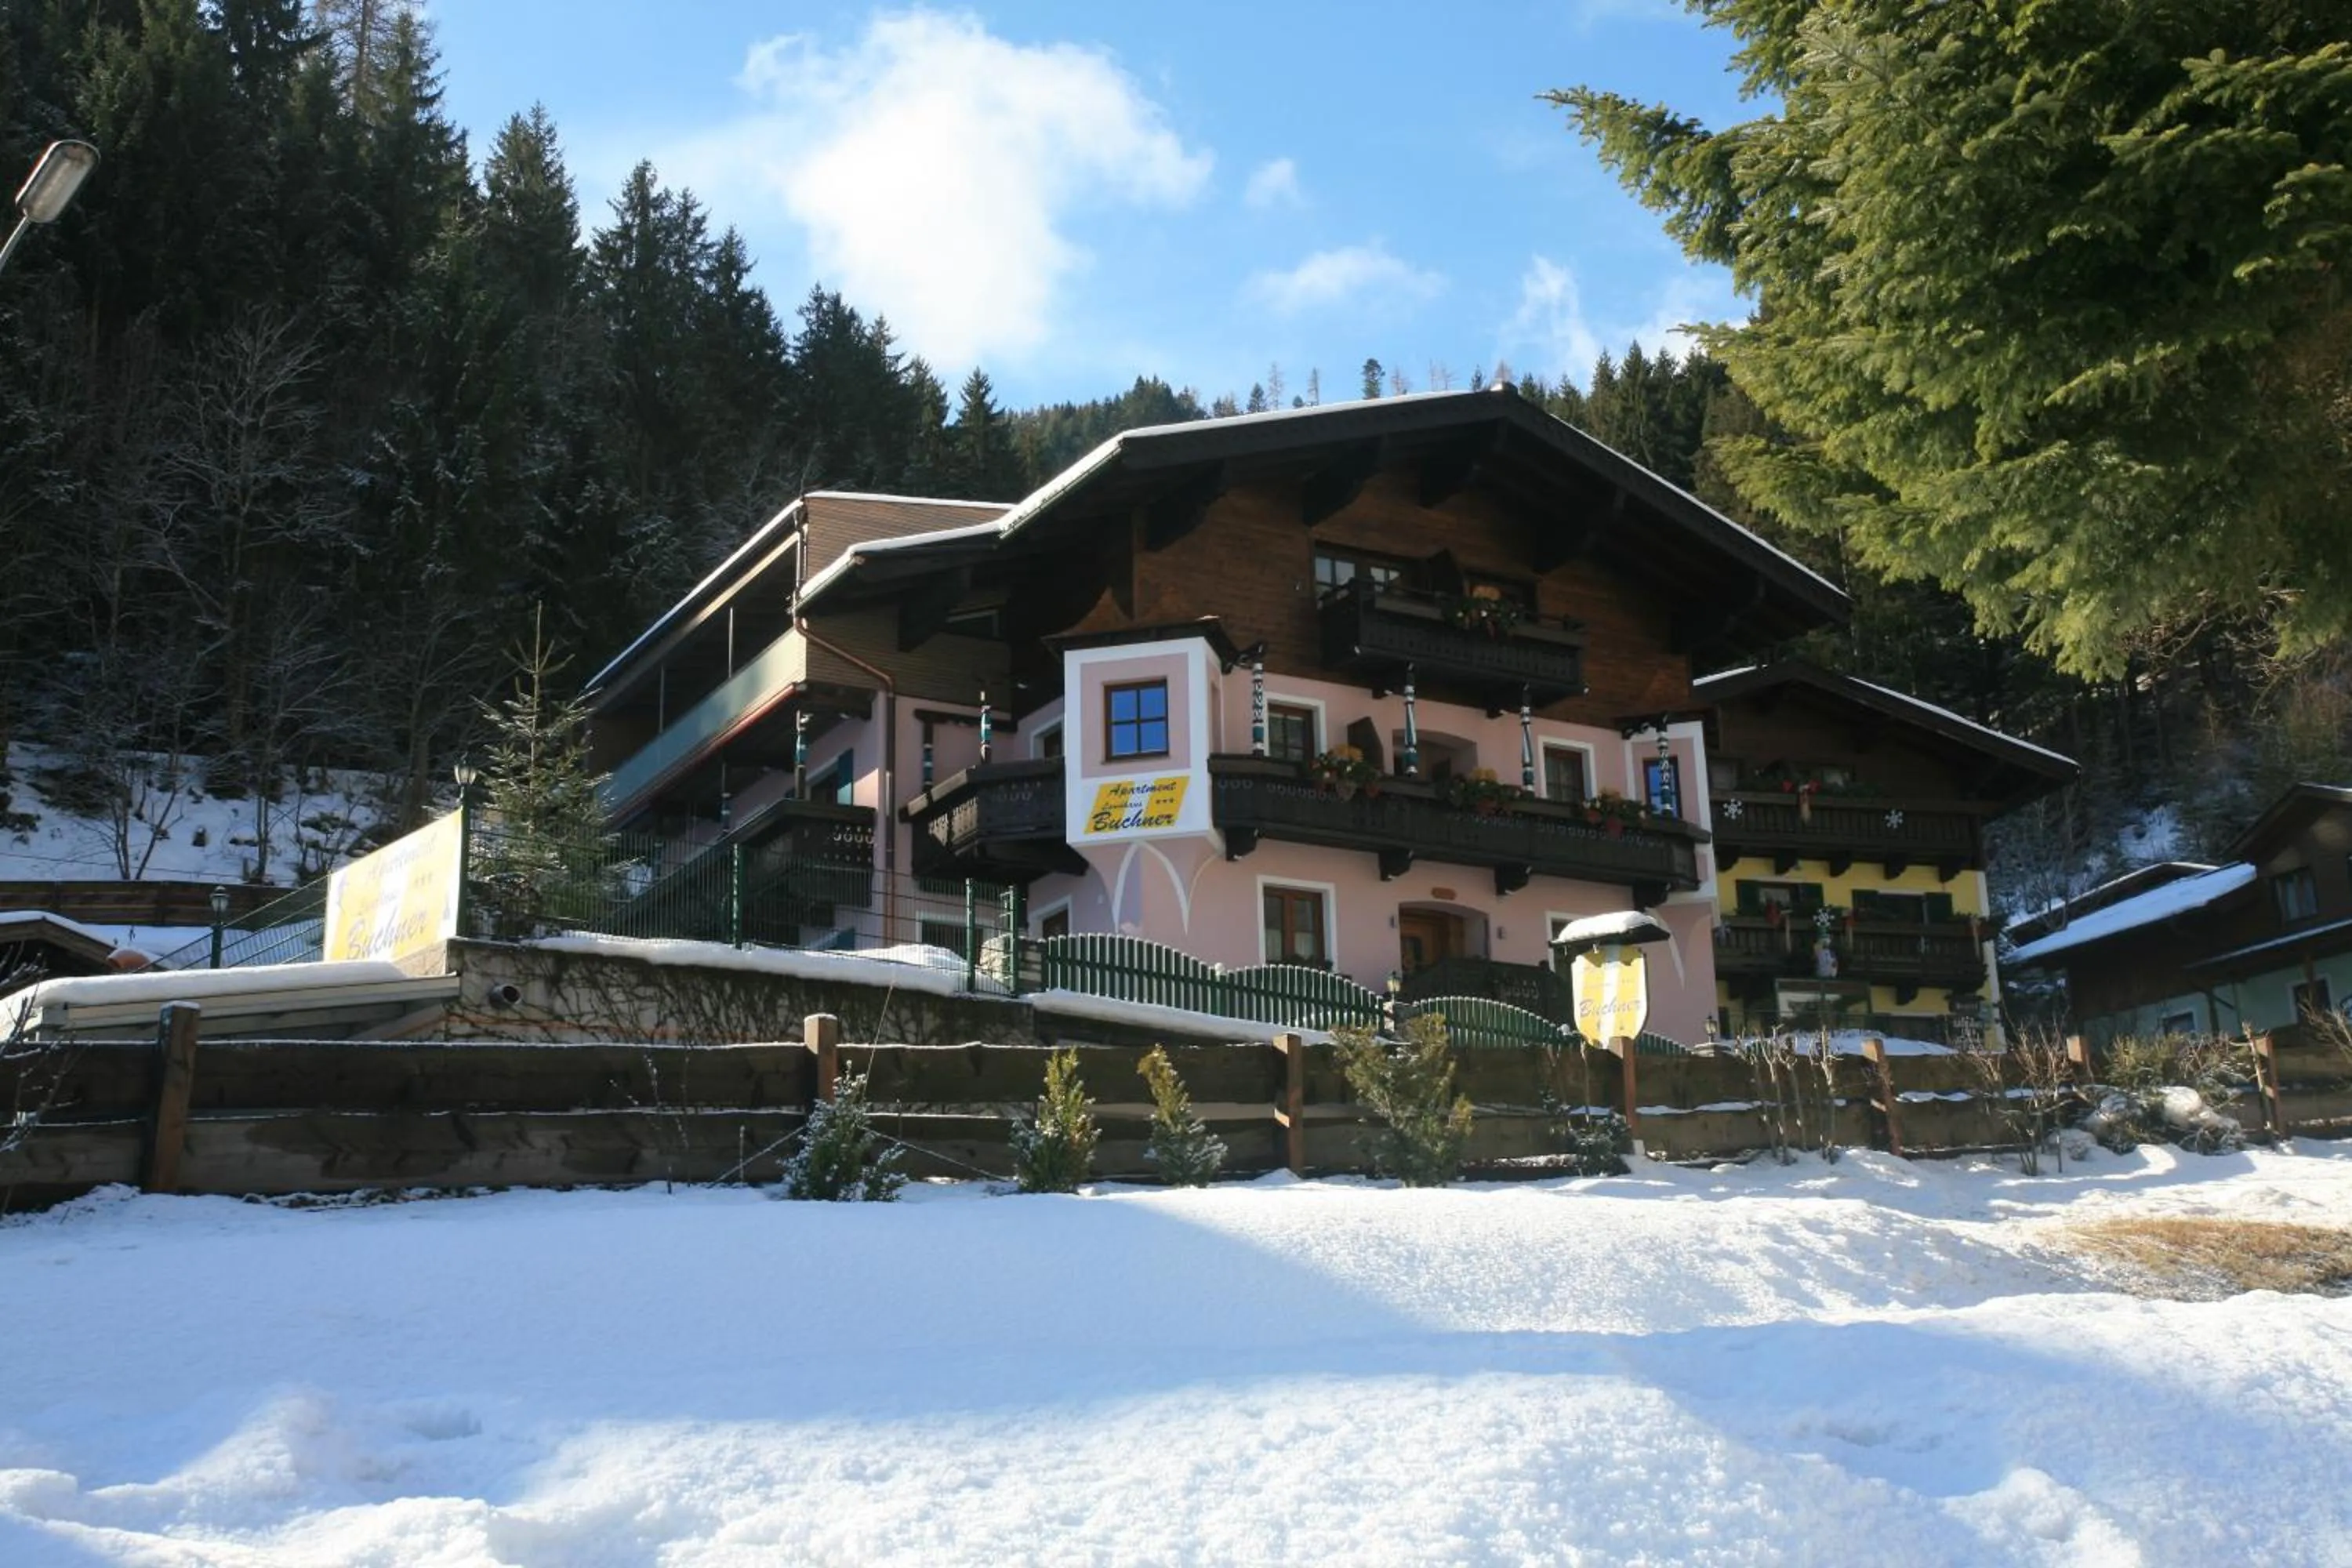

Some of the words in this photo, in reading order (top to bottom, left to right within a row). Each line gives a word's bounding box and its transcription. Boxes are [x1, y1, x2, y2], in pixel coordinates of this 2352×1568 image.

[1109, 782, 1177, 797] Apartment
[1092, 809, 1174, 832] Buchner
[347, 904, 427, 960] Buchner
[1579, 995, 1642, 1018] Buchner
